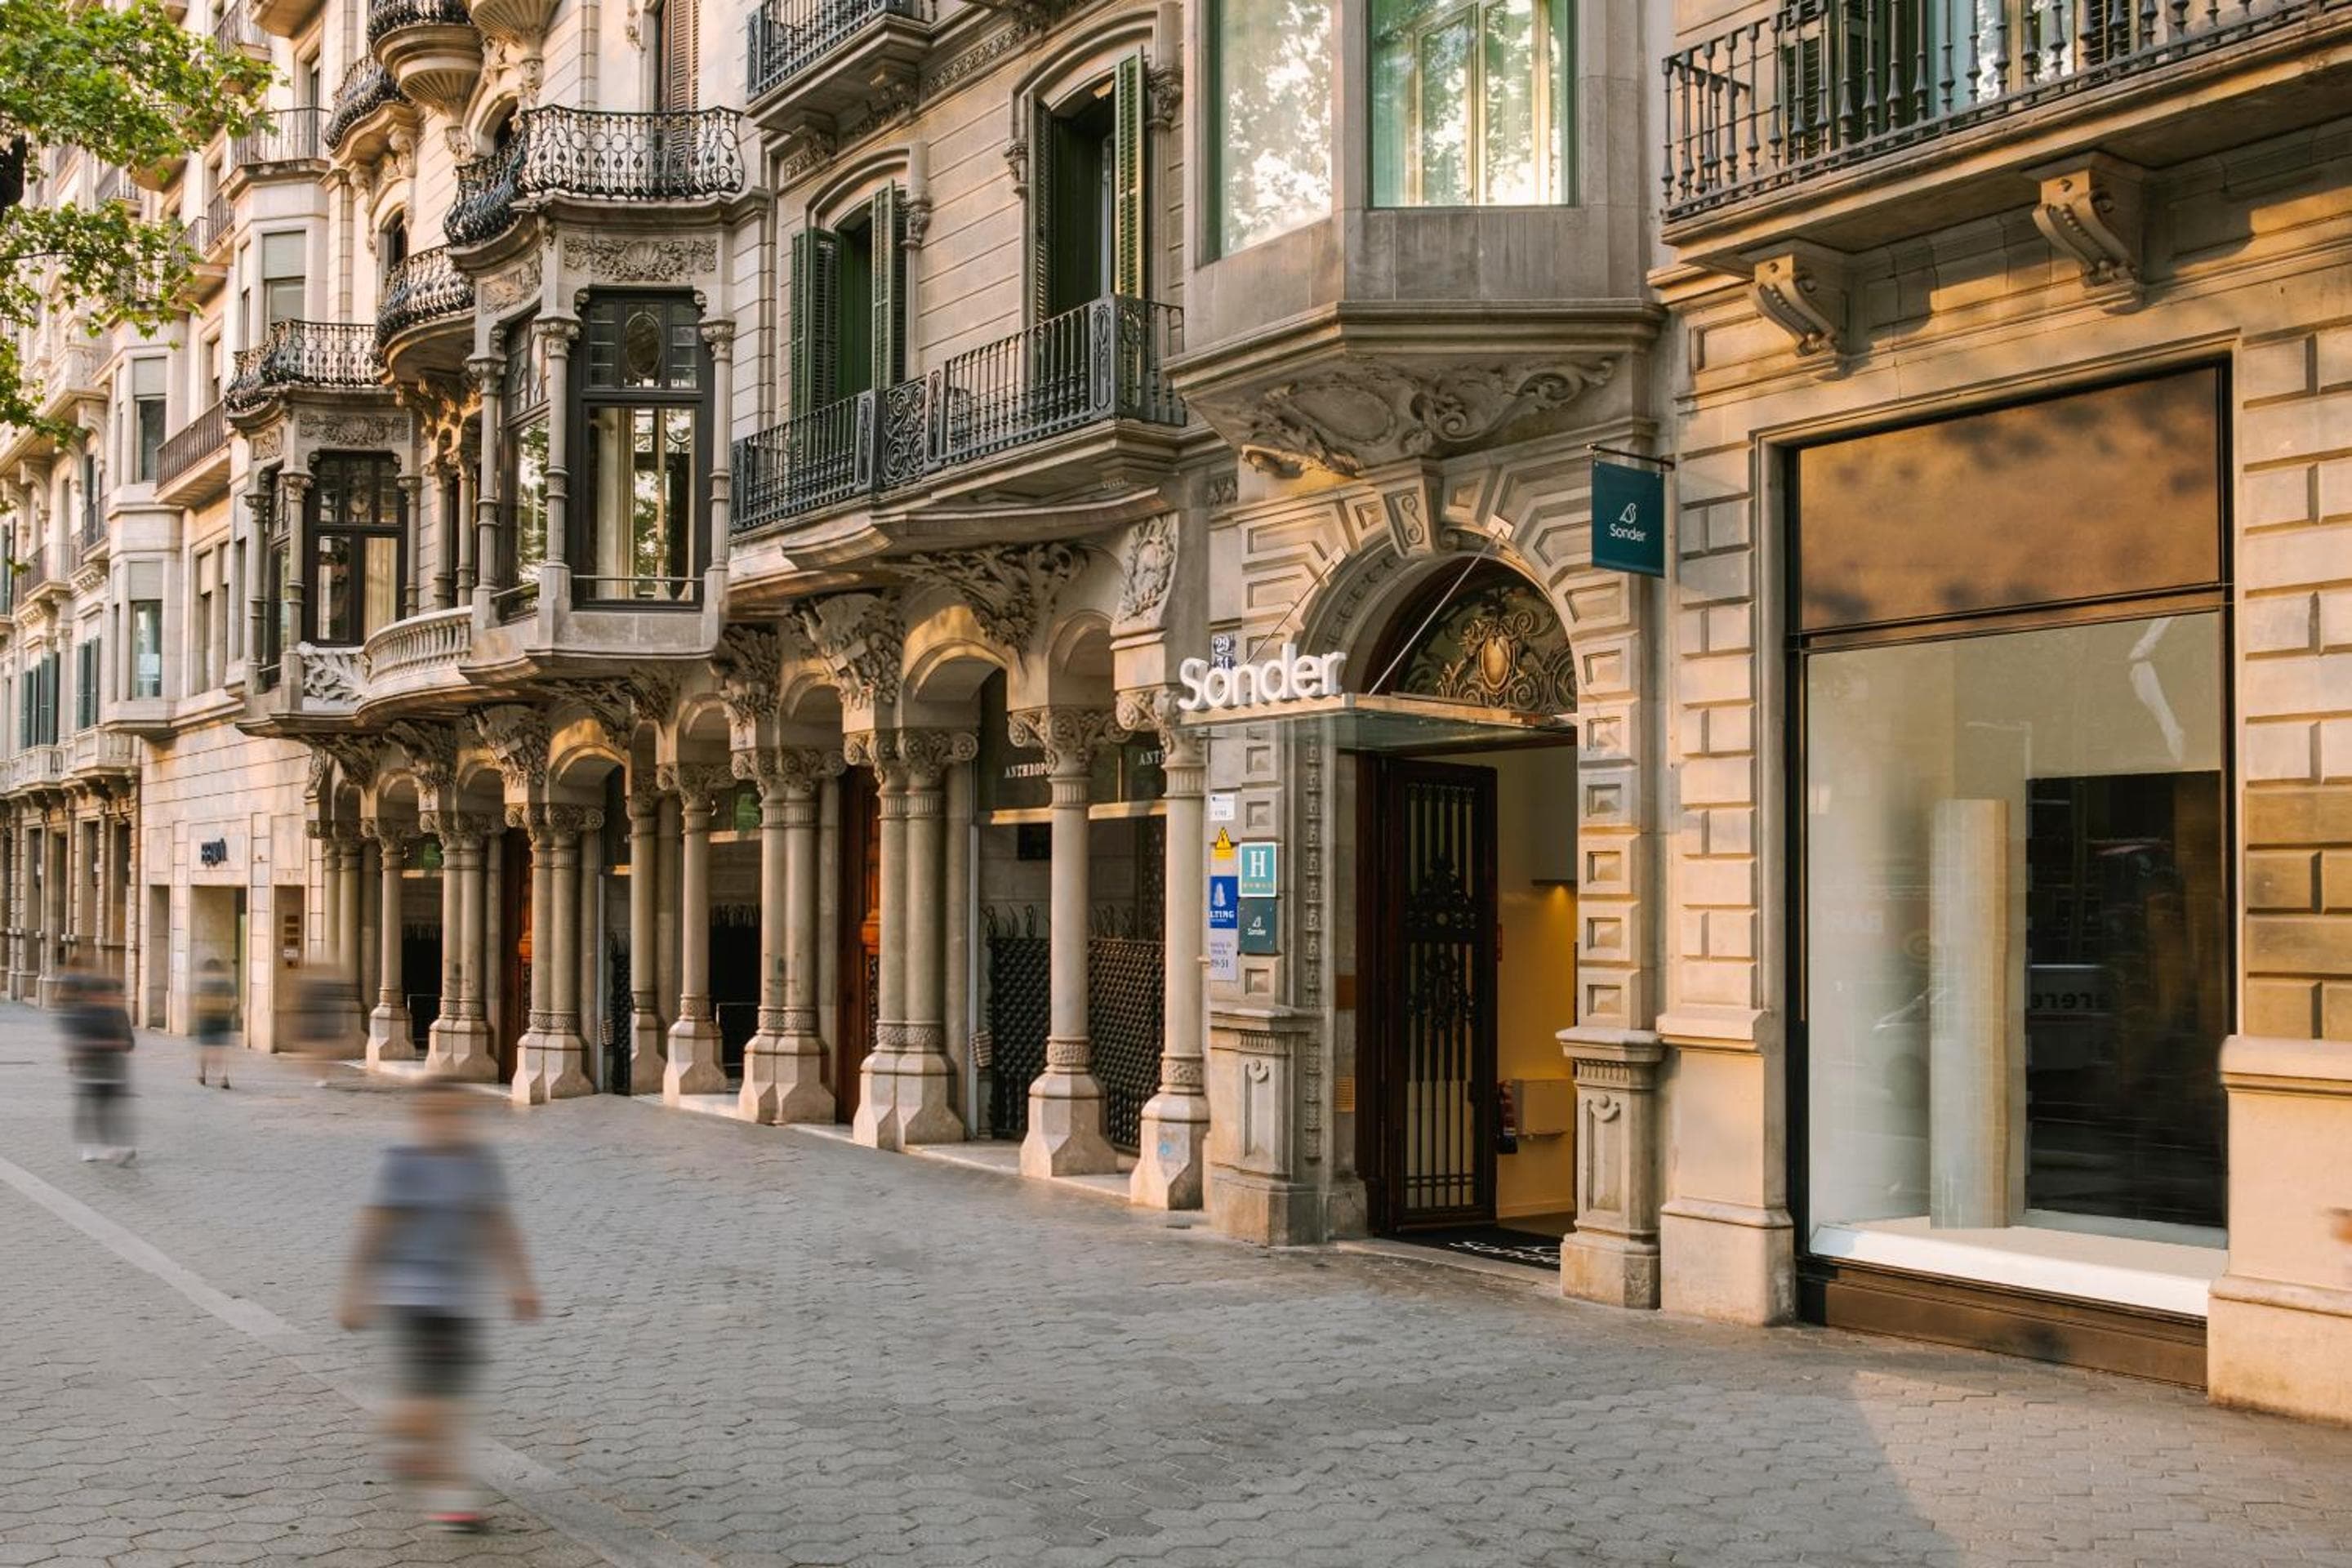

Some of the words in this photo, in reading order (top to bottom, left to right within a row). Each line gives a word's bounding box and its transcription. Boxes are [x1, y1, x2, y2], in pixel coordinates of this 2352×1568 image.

[1610, 523, 1646, 542] Sonder
[1215, 637, 1229, 652] 29
[1177, 642, 1347, 710] Sonder
[1250, 851, 1266, 877] H
